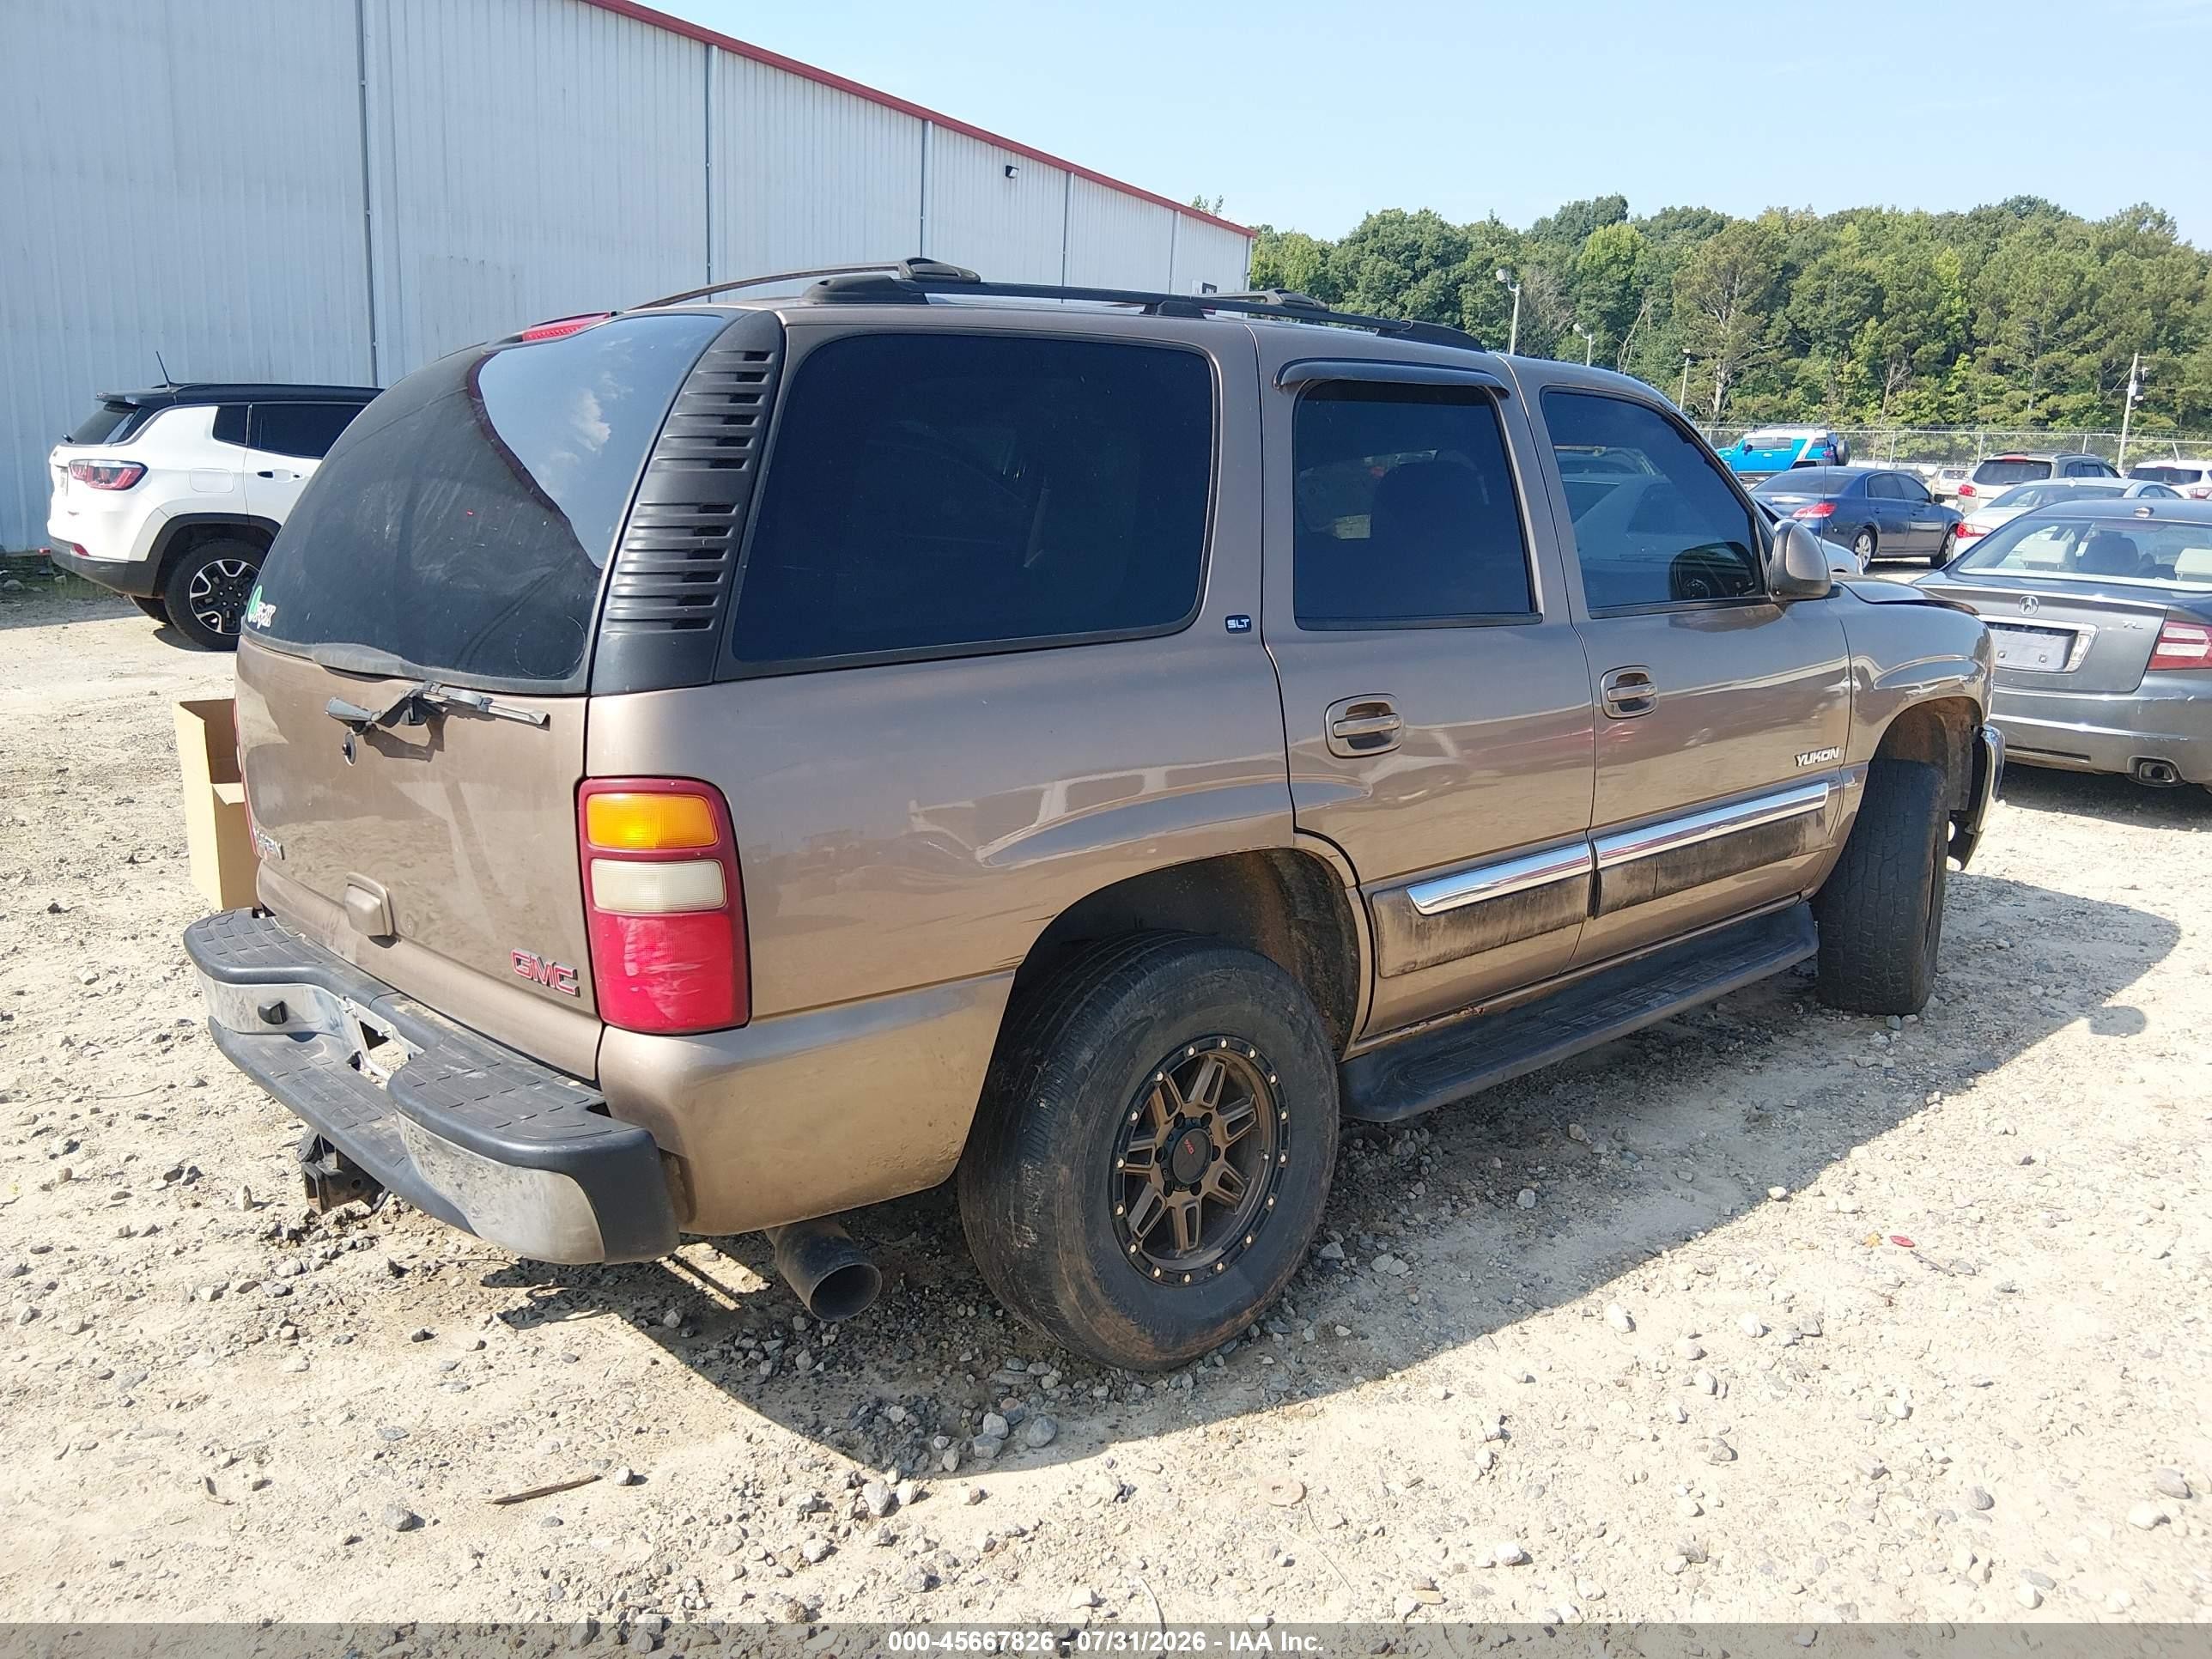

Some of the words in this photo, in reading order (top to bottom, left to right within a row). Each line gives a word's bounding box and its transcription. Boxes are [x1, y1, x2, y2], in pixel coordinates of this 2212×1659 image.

[1227, 618, 1250, 629] SLT
[1795, 746, 1839, 767] YUKON
[511, 949, 580, 997] GMC
